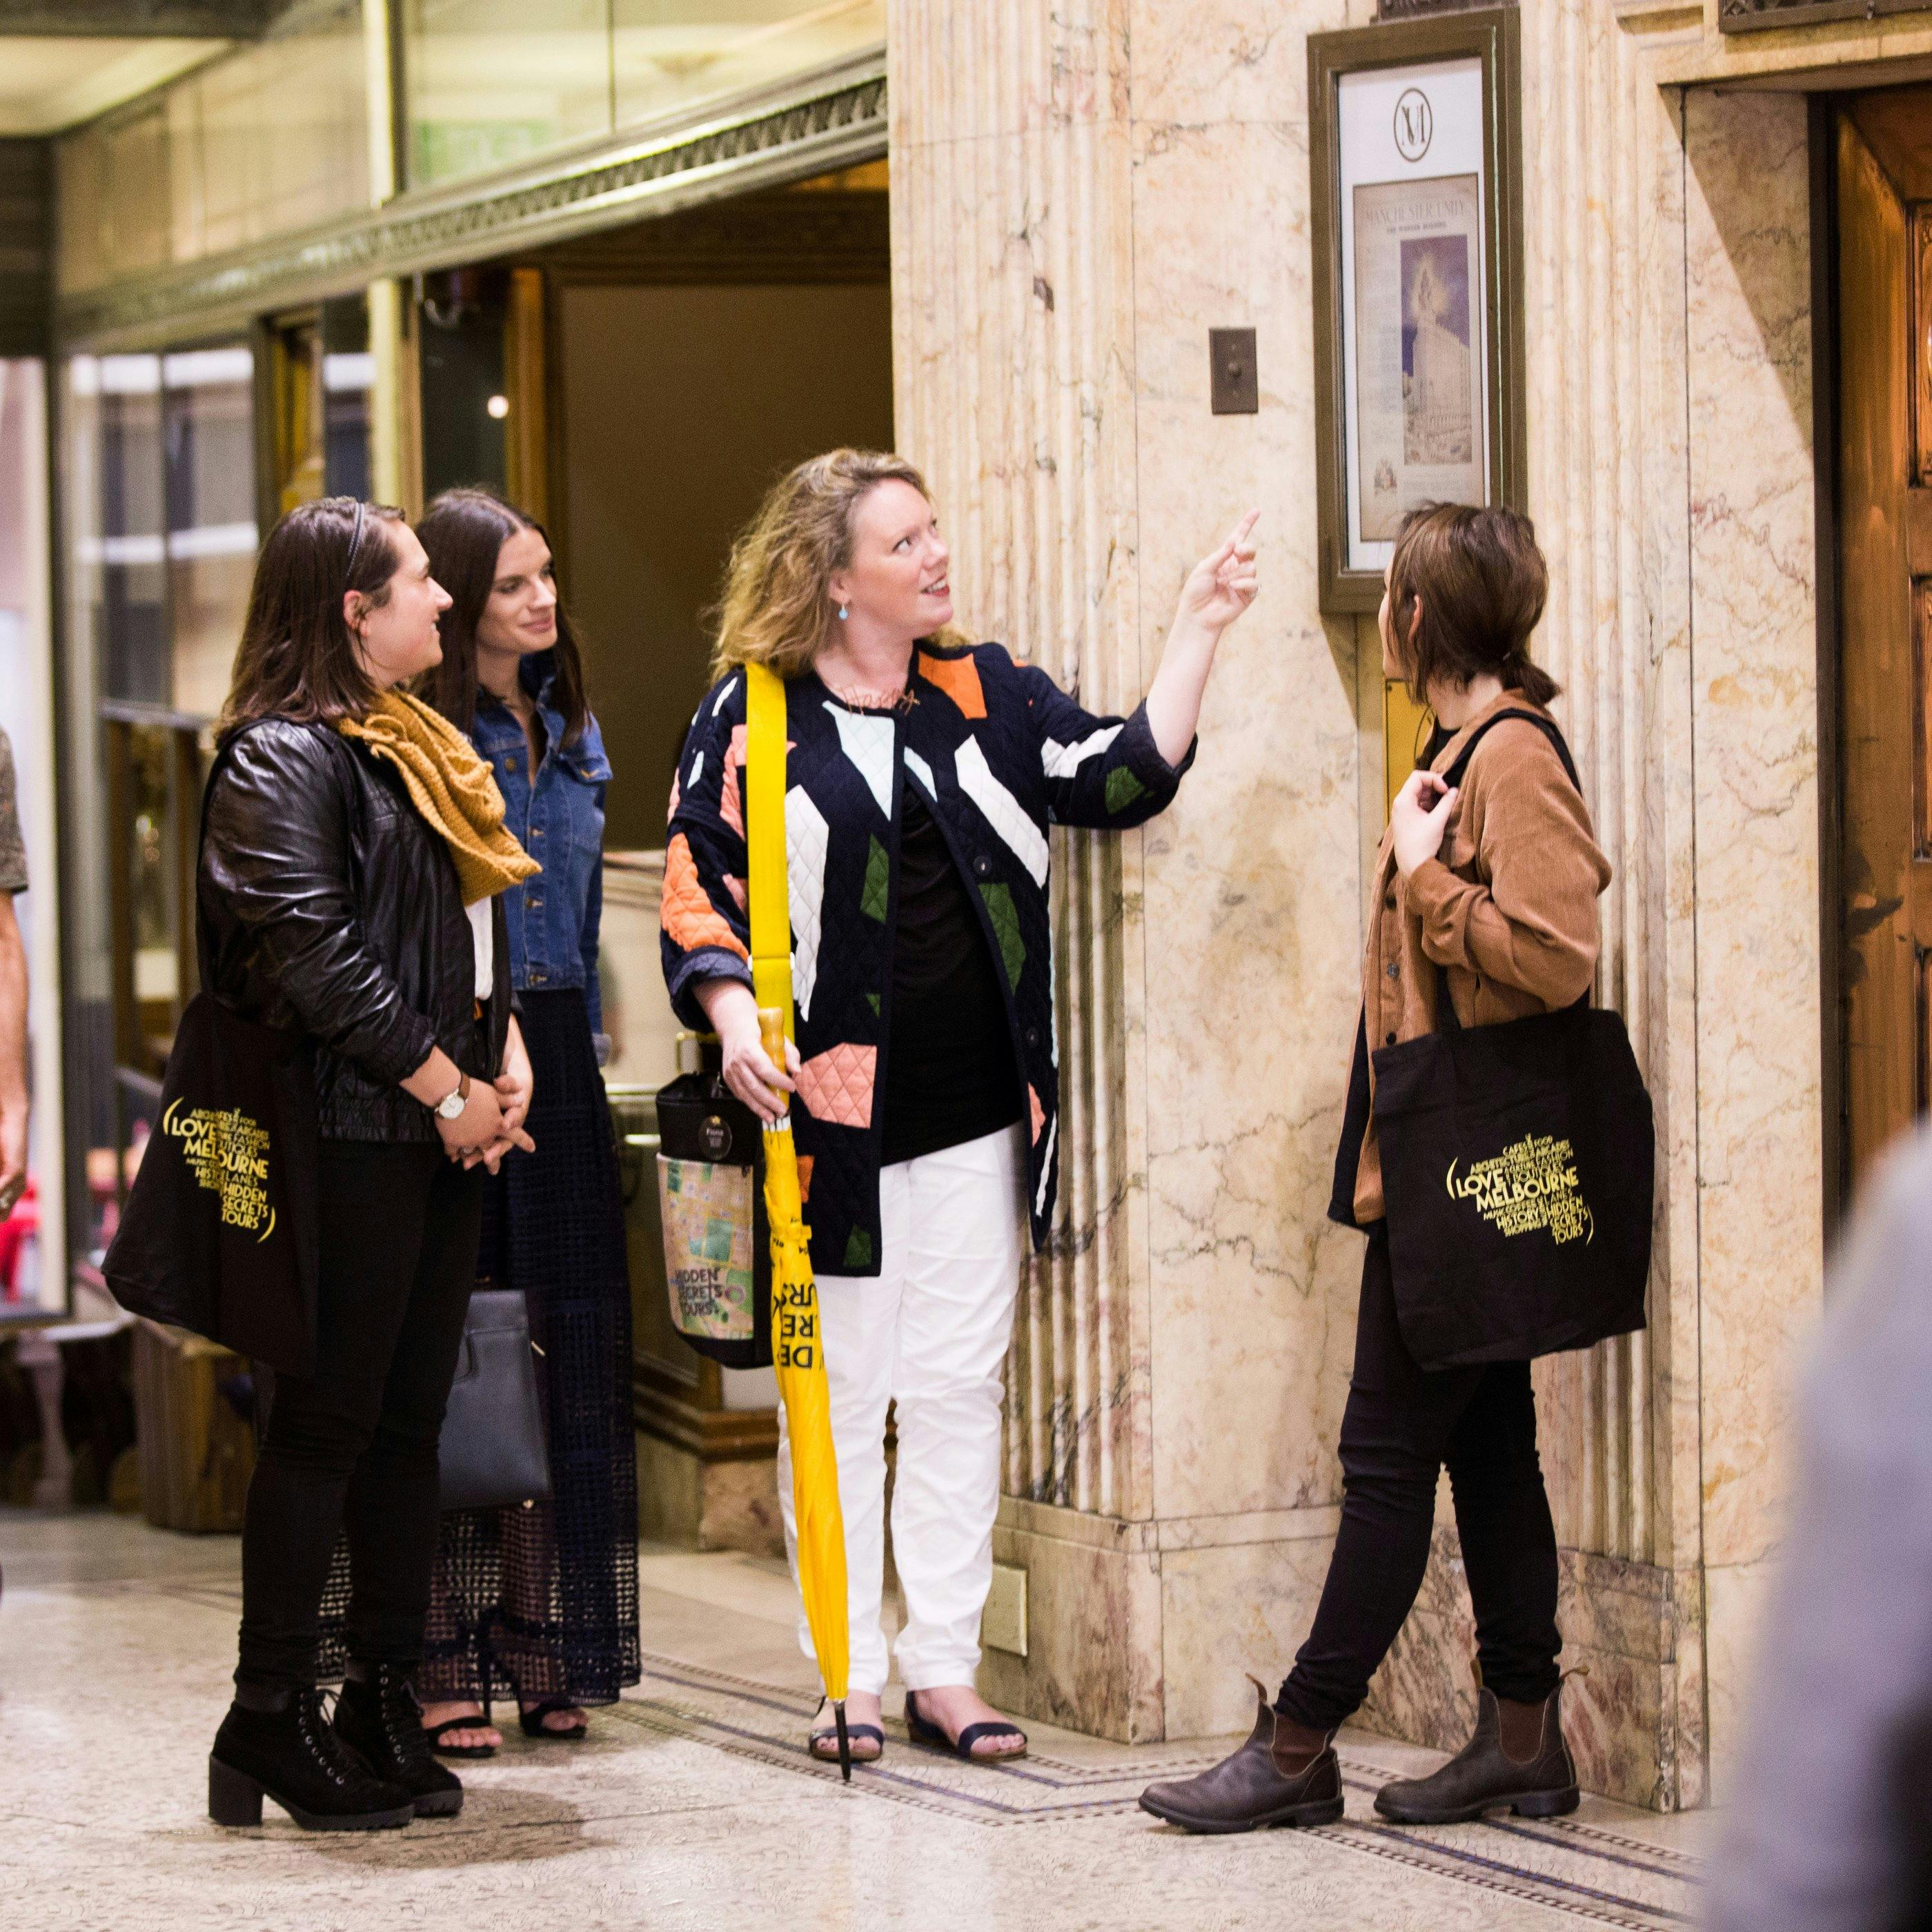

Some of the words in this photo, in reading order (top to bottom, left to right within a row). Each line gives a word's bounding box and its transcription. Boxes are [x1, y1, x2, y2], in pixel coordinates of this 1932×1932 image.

[171, 1116, 216, 1139] LOVE
[183, 1136, 269, 1179] MELOURNE
[226, 1171, 259, 1187] LANES
[1455, 1167, 1504, 1199] LOVE
[1536, 1147, 1573, 1166] FASHION
[223, 1182, 267, 1203] HIDDEN
[1476, 1165, 1579, 1212] MELBOURNE
[222, 1195, 268, 1218] SECRETS
[1496, 1206, 1539, 1230] HISTORY
[1546, 1194, 1583, 1219] HIDDEN
[1550, 1206, 1588, 1230] SECRETS
[221, 1208, 259, 1229] TOURS
[1552, 1225, 1584, 1245] TOURS
